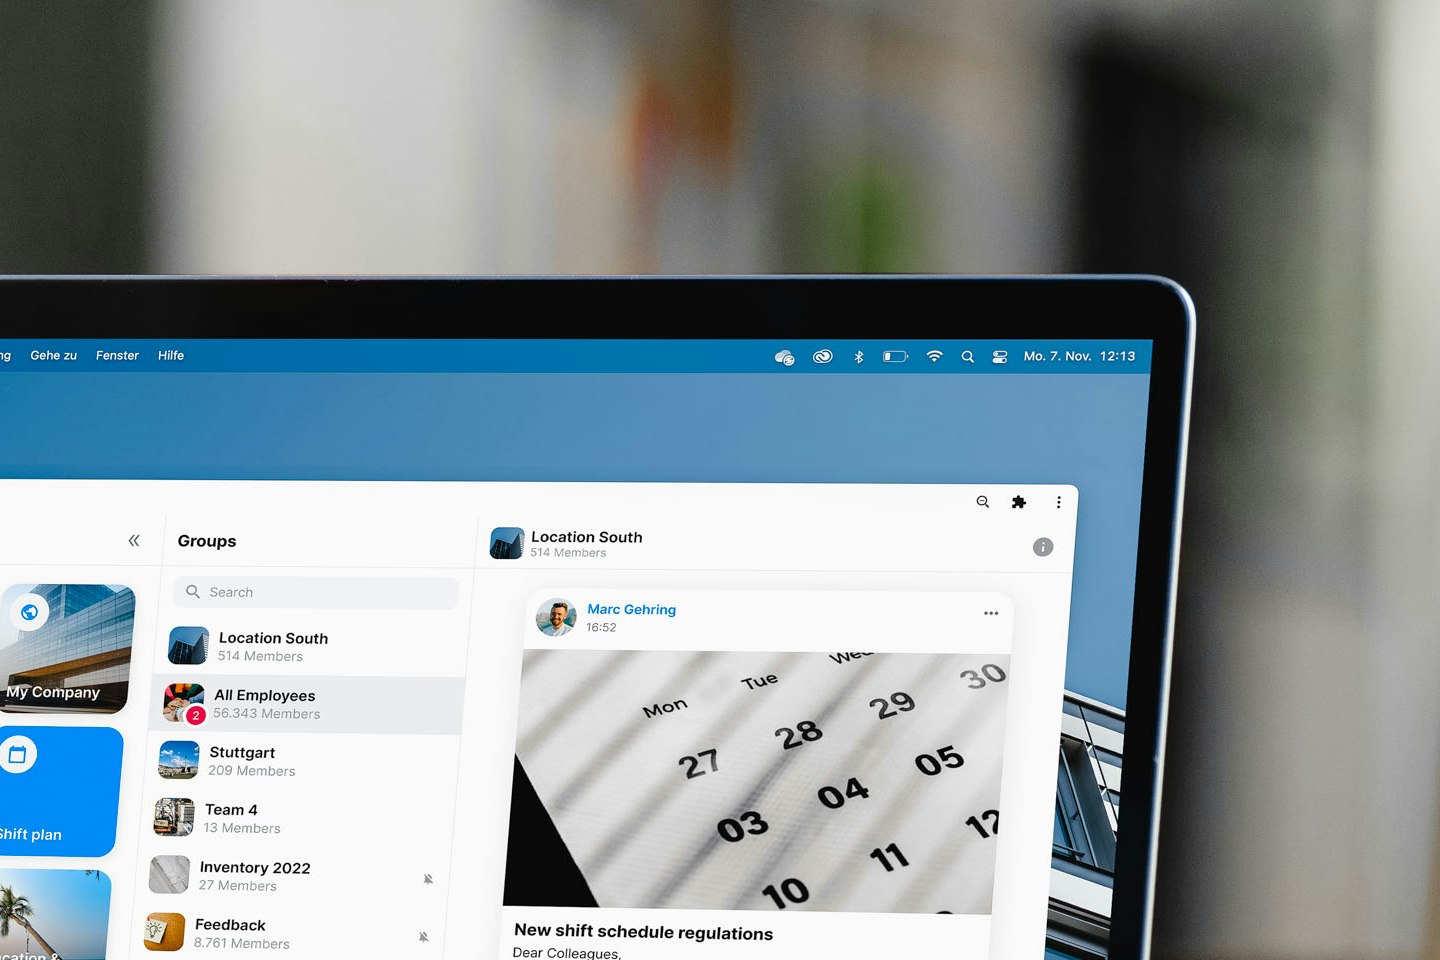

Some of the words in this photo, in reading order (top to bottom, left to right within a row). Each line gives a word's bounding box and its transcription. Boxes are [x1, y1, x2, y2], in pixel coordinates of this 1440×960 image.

[31, 350, 60, 360] Gehe
[96, 351, 139, 360] Fenster
[158, 350, 184, 360] Hilfe
[1024, 351, 1046, 361] Mo.
[1050, 351, 1061, 361] 7.
[1066, 351, 1091, 361] Nov.
[1101, 351, 1135, 361] 12:13
[178, 535, 236, 550] Groups
[532, 531, 594, 543] Location
[599, 531, 642, 543] South
[531, 548, 550, 557] 514
[554, 548, 606, 557] Members
[210, 587, 253, 597] Search
[588, 604, 620, 614] Marc
[624, 604, 676, 617] Gehring
[587, 623, 616, 632] 16:52
[220, 632, 281, 644] Location
[286, 633, 328, 644] South
[218, 651, 240, 661] 514
[245, 651, 303, 661] Members
[6, 686, 29, 700] My
[31, 686, 100, 701] Company
[214, 689, 232, 700] All
[237, 690, 315, 704] Employees
[642, 700, 688, 718] Mon
[741, 675, 778, 689] Tue
[192, 711, 199, 720] 2
[214, 708, 257, 718] 56.343
[262, 708, 320, 719] Members
[679, 748, 718, 779] 27
[775, 721, 823, 751] 28
[870, 692, 915, 720] 29
[960, 664, 1006, 689] 30
[210, 746, 275, 761] Stuttgart
[208, 765, 232, 775] 209
[237, 765, 295, 776] Members
[716, 810, 769, 844] 03
[818, 777, 869, 809] 04
[915, 745, 964, 776] 05
[206, 804, 244, 815] Team
[248, 805, 257, 815] 4
[204, 822, 217, 832] 13
[222, 823, 280, 834] Members
[32, 829, 61, 843] plan
[201, 861, 269, 876] Inventory
[273, 862, 310, 874] 2022
[762, 878, 809, 909] 10
[869, 843, 909, 872] 11
[199, 880, 214, 890] 27
[218, 880, 276, 891] Members
[196, 919, 265, 931] Feedback
[515, 923, 551, 936] New
[556, 924, 593, 937] shift
[598, 925, 674, 938] schedule
[679, 927, 773, 942] regulations
[194, 937, 226, 948] 8.761
[231, 938, 290, 949] Members
[513, 947, 543, 958] Dear
